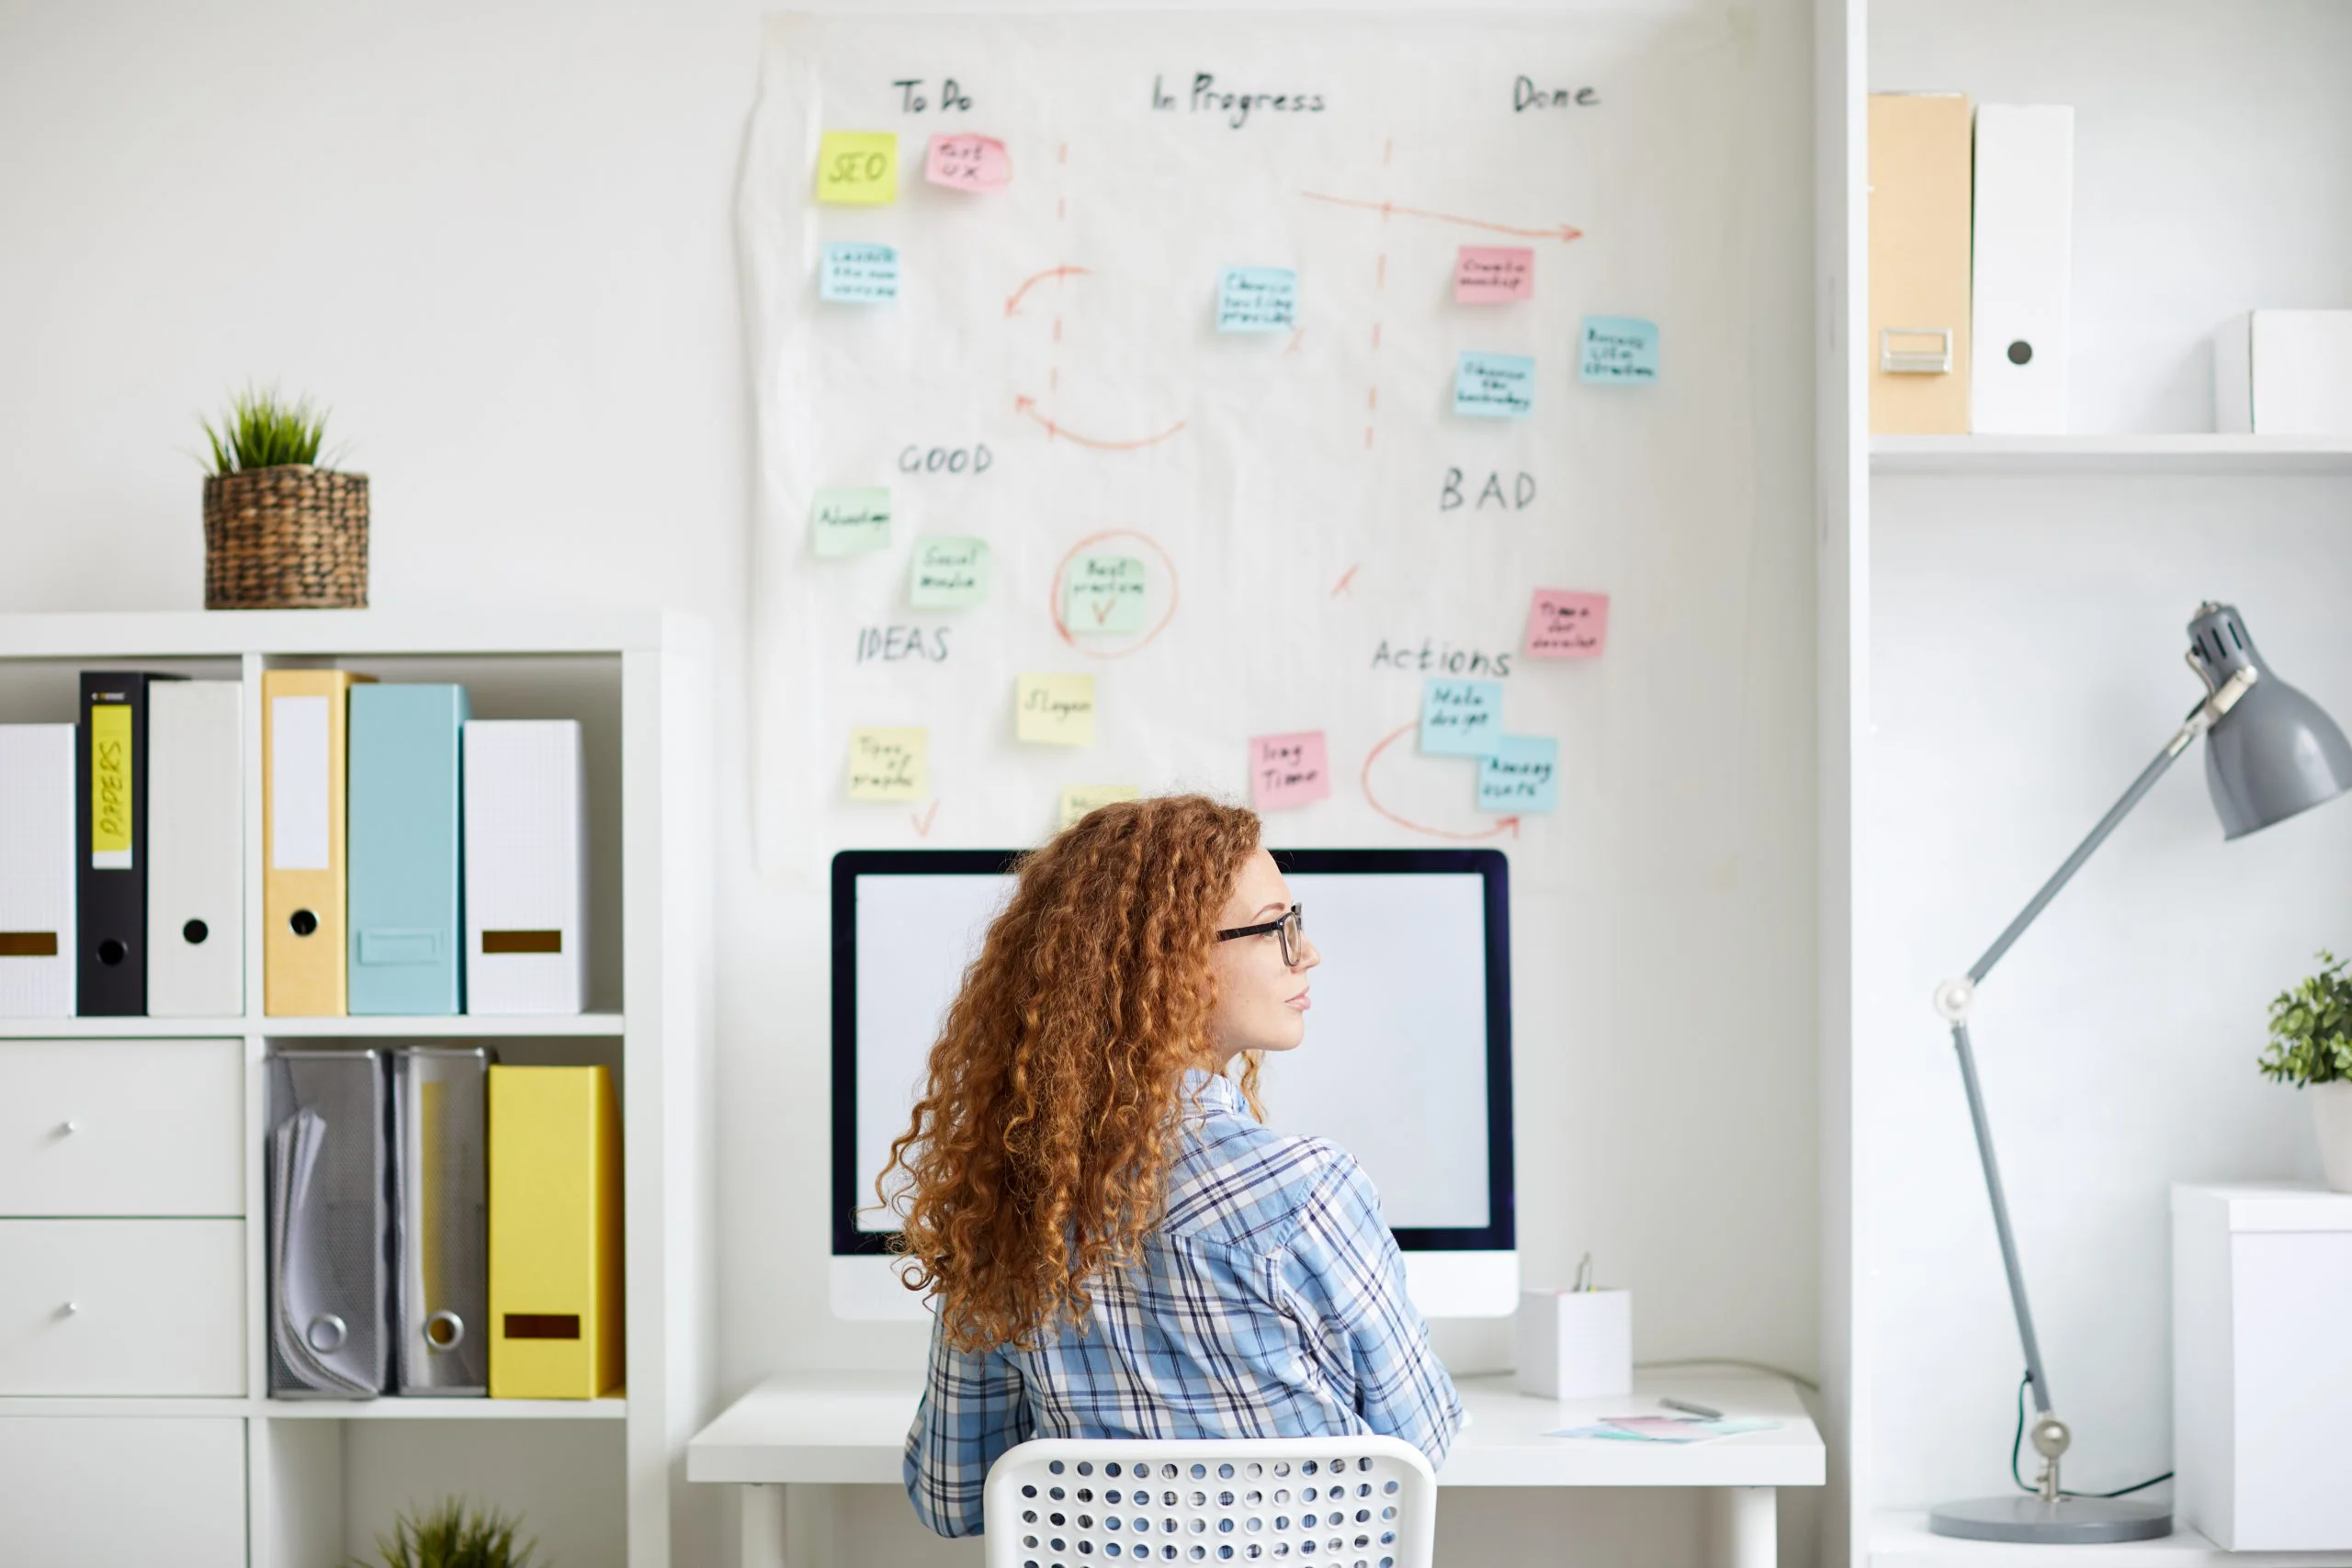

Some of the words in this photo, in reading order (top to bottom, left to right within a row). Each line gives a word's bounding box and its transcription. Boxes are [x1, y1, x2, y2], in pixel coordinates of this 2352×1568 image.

[891, 79, 927, 113] To
[940, 78, 973, 112] Do
[1152, 74, 1175, 110] In
[1192, 72, 1326, 129] Progress
[1513, 74, 1600, 112] Done
[828, 152, 888, 184] SEO
[899, 443, 993, 474] GOOD
[1439, 467, 1537, 512] BAD
[856, 626, 952, 664] IDEAS
[1370, 637, 1513, 678] Actions
